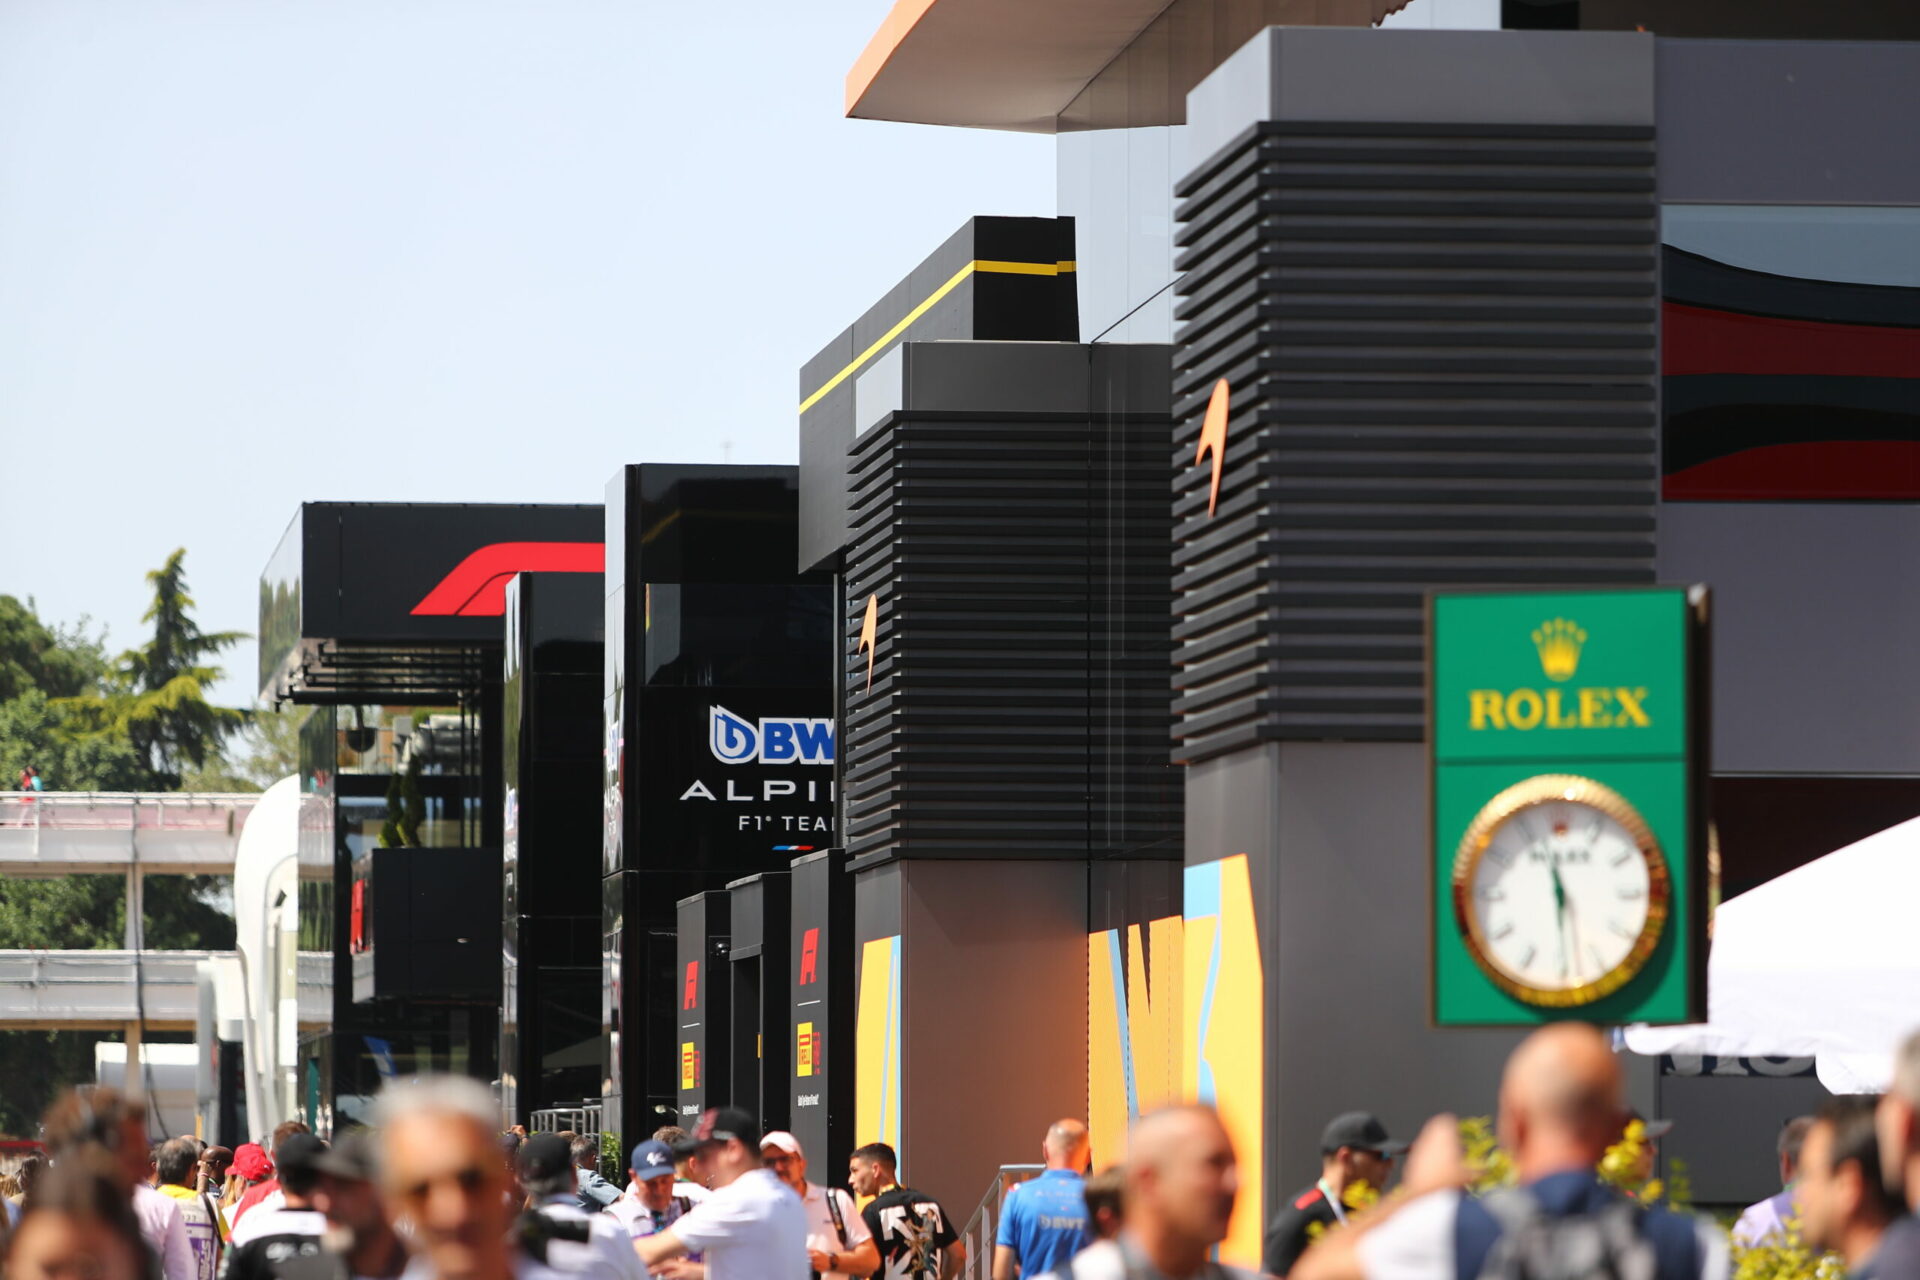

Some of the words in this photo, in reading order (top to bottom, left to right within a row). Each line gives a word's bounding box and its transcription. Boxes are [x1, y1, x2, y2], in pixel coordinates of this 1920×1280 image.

[1469, 688, 1649, 729] ROLEX
[679, 780, 834, 801] ALPI
[781, 816, 834, 831] TEA
